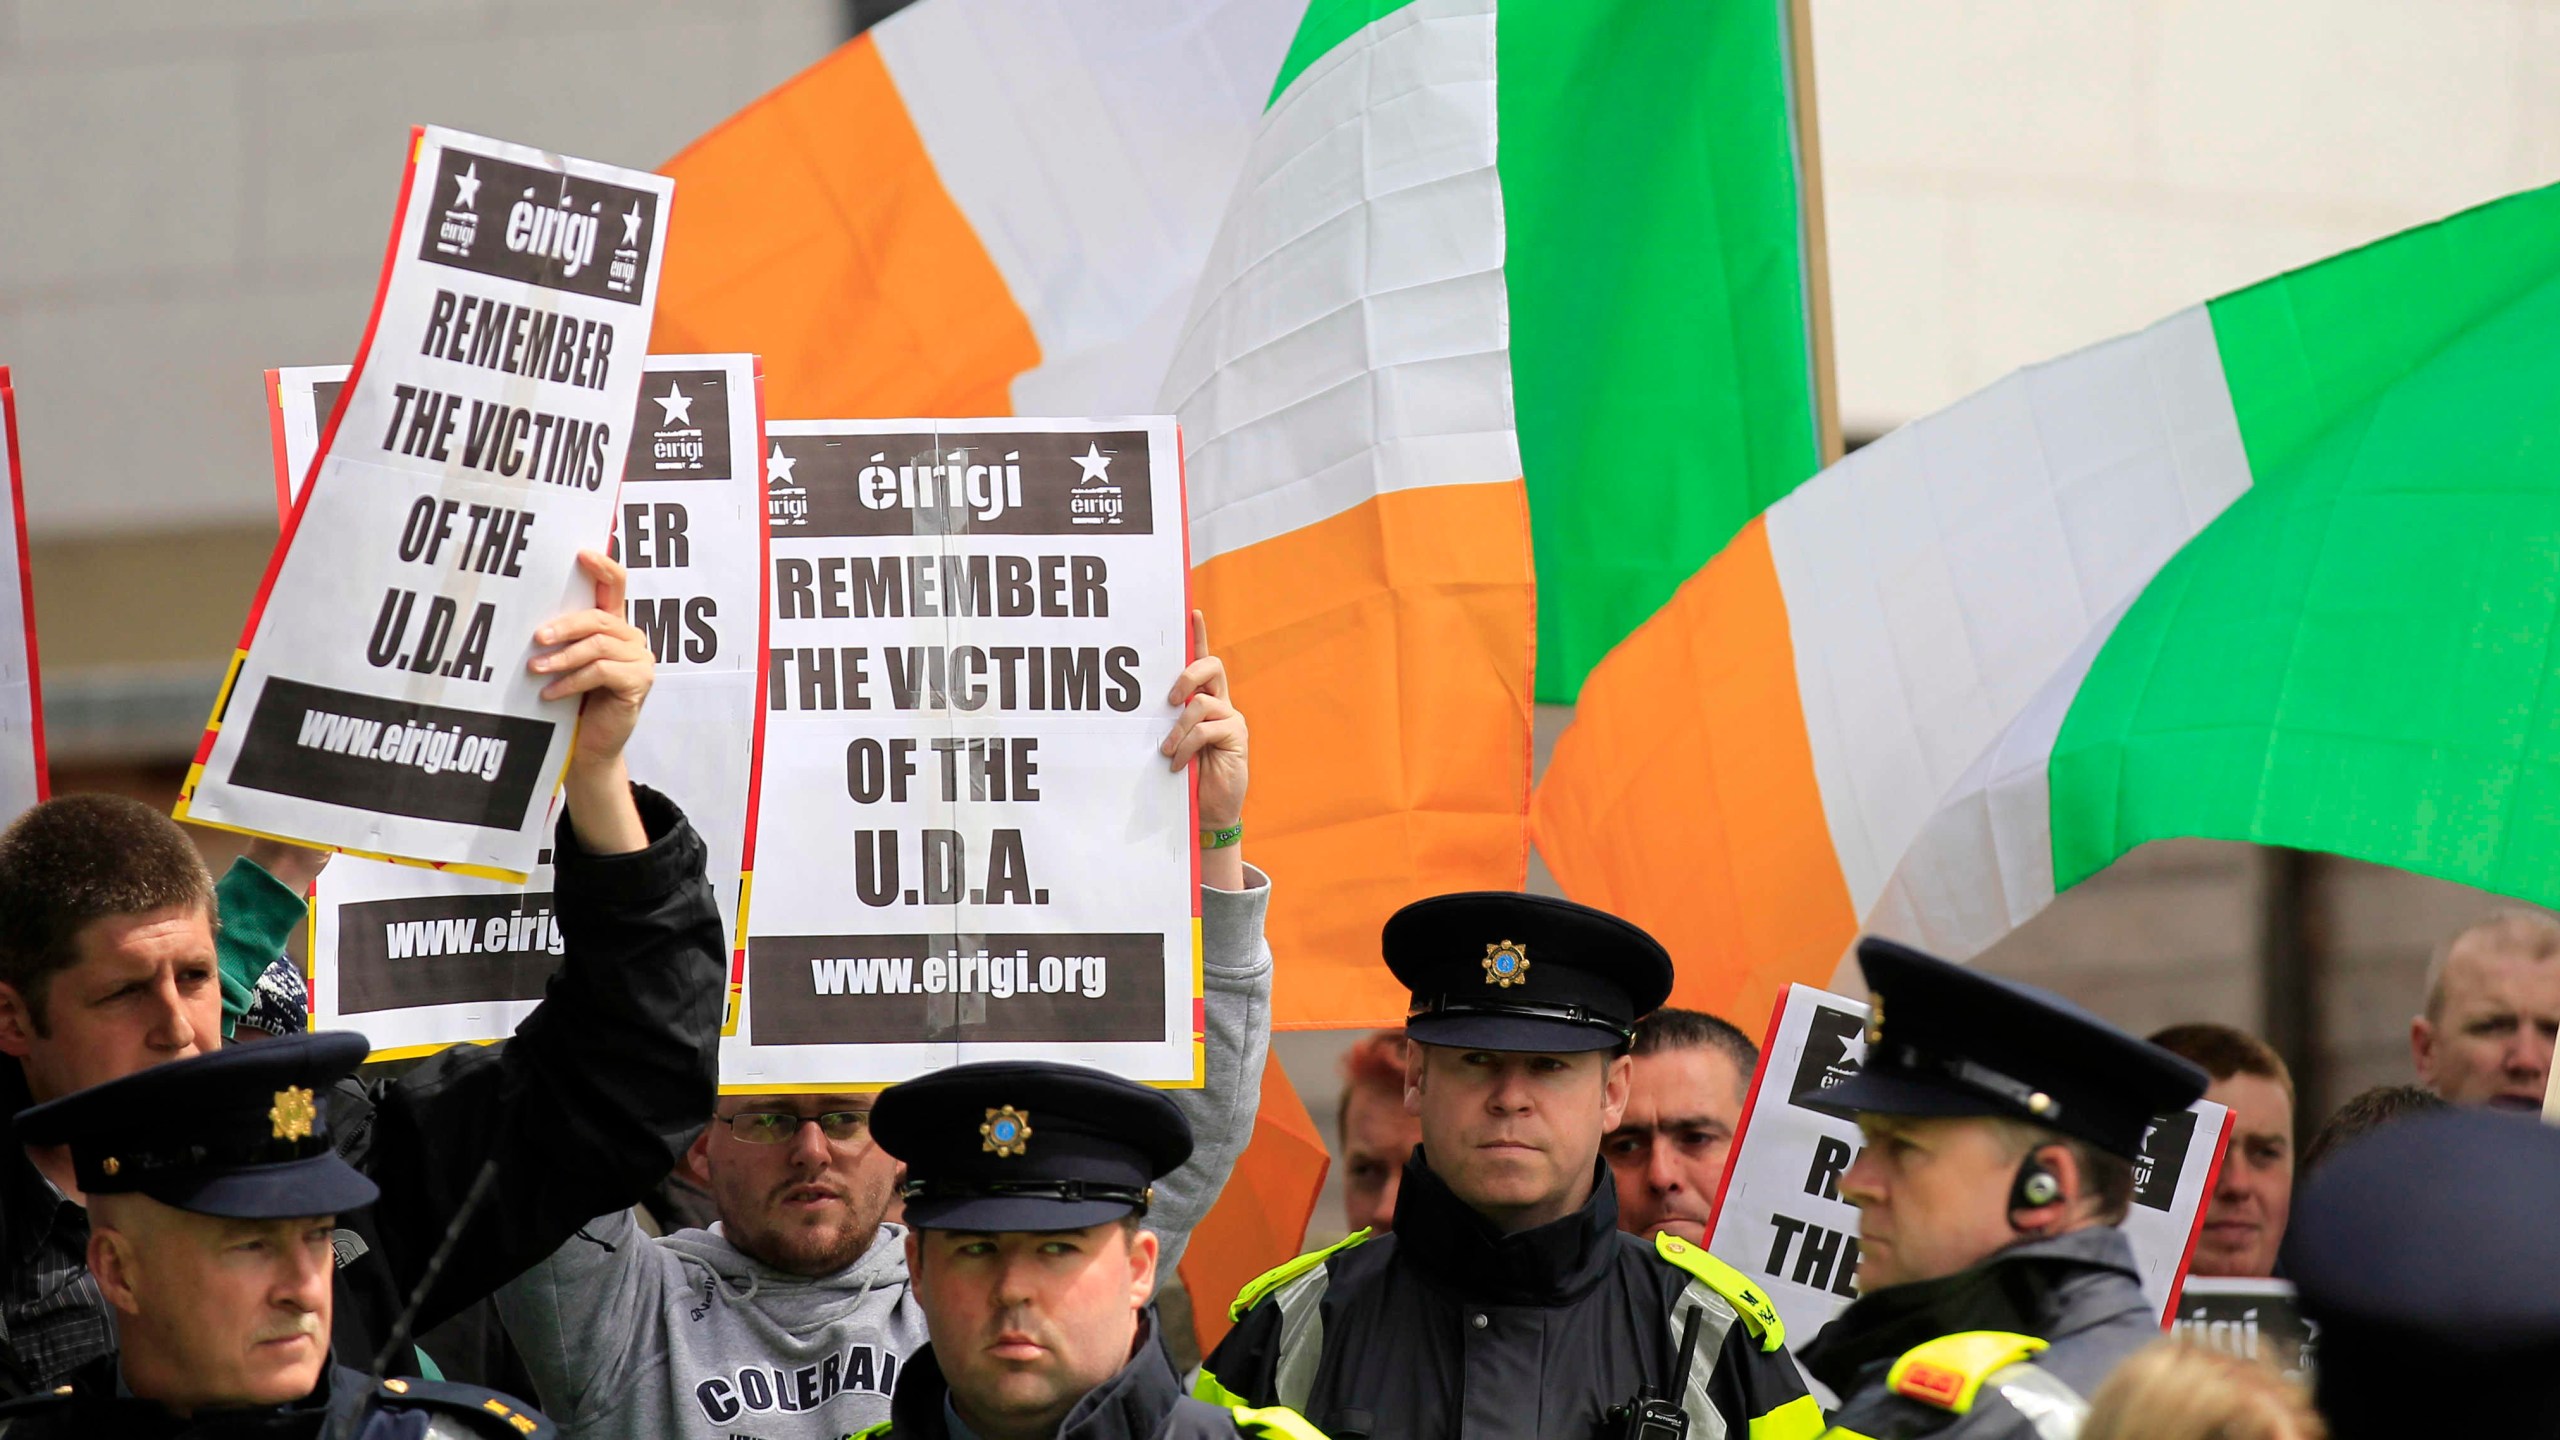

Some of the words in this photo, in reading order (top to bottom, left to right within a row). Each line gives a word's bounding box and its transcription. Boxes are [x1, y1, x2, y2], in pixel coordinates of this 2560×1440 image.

[421, 289, 614, 391] REMEMBER
[382, 383, 463, 461] THE
[462, 400, 609, 491] VICTIMS
[399, 495, 459, 565] OF
[460, 502, 536, 577] THE
[775, 555, 1109, 619] REMEMBER
[367, 587, 495, 682] U.D.A.
[769, 646, 883, 711] THE
[884, 645, 1142, 712] VICTIMS
[297, 709, 508, 782] www.eirigi.org
[847, 738, 916, 804] OF
[931, 738, 1040, 802] THE
[854, 829, 1049, 907] U.D.A.
[811, 949, 1107, 998] www.eirigi.org
